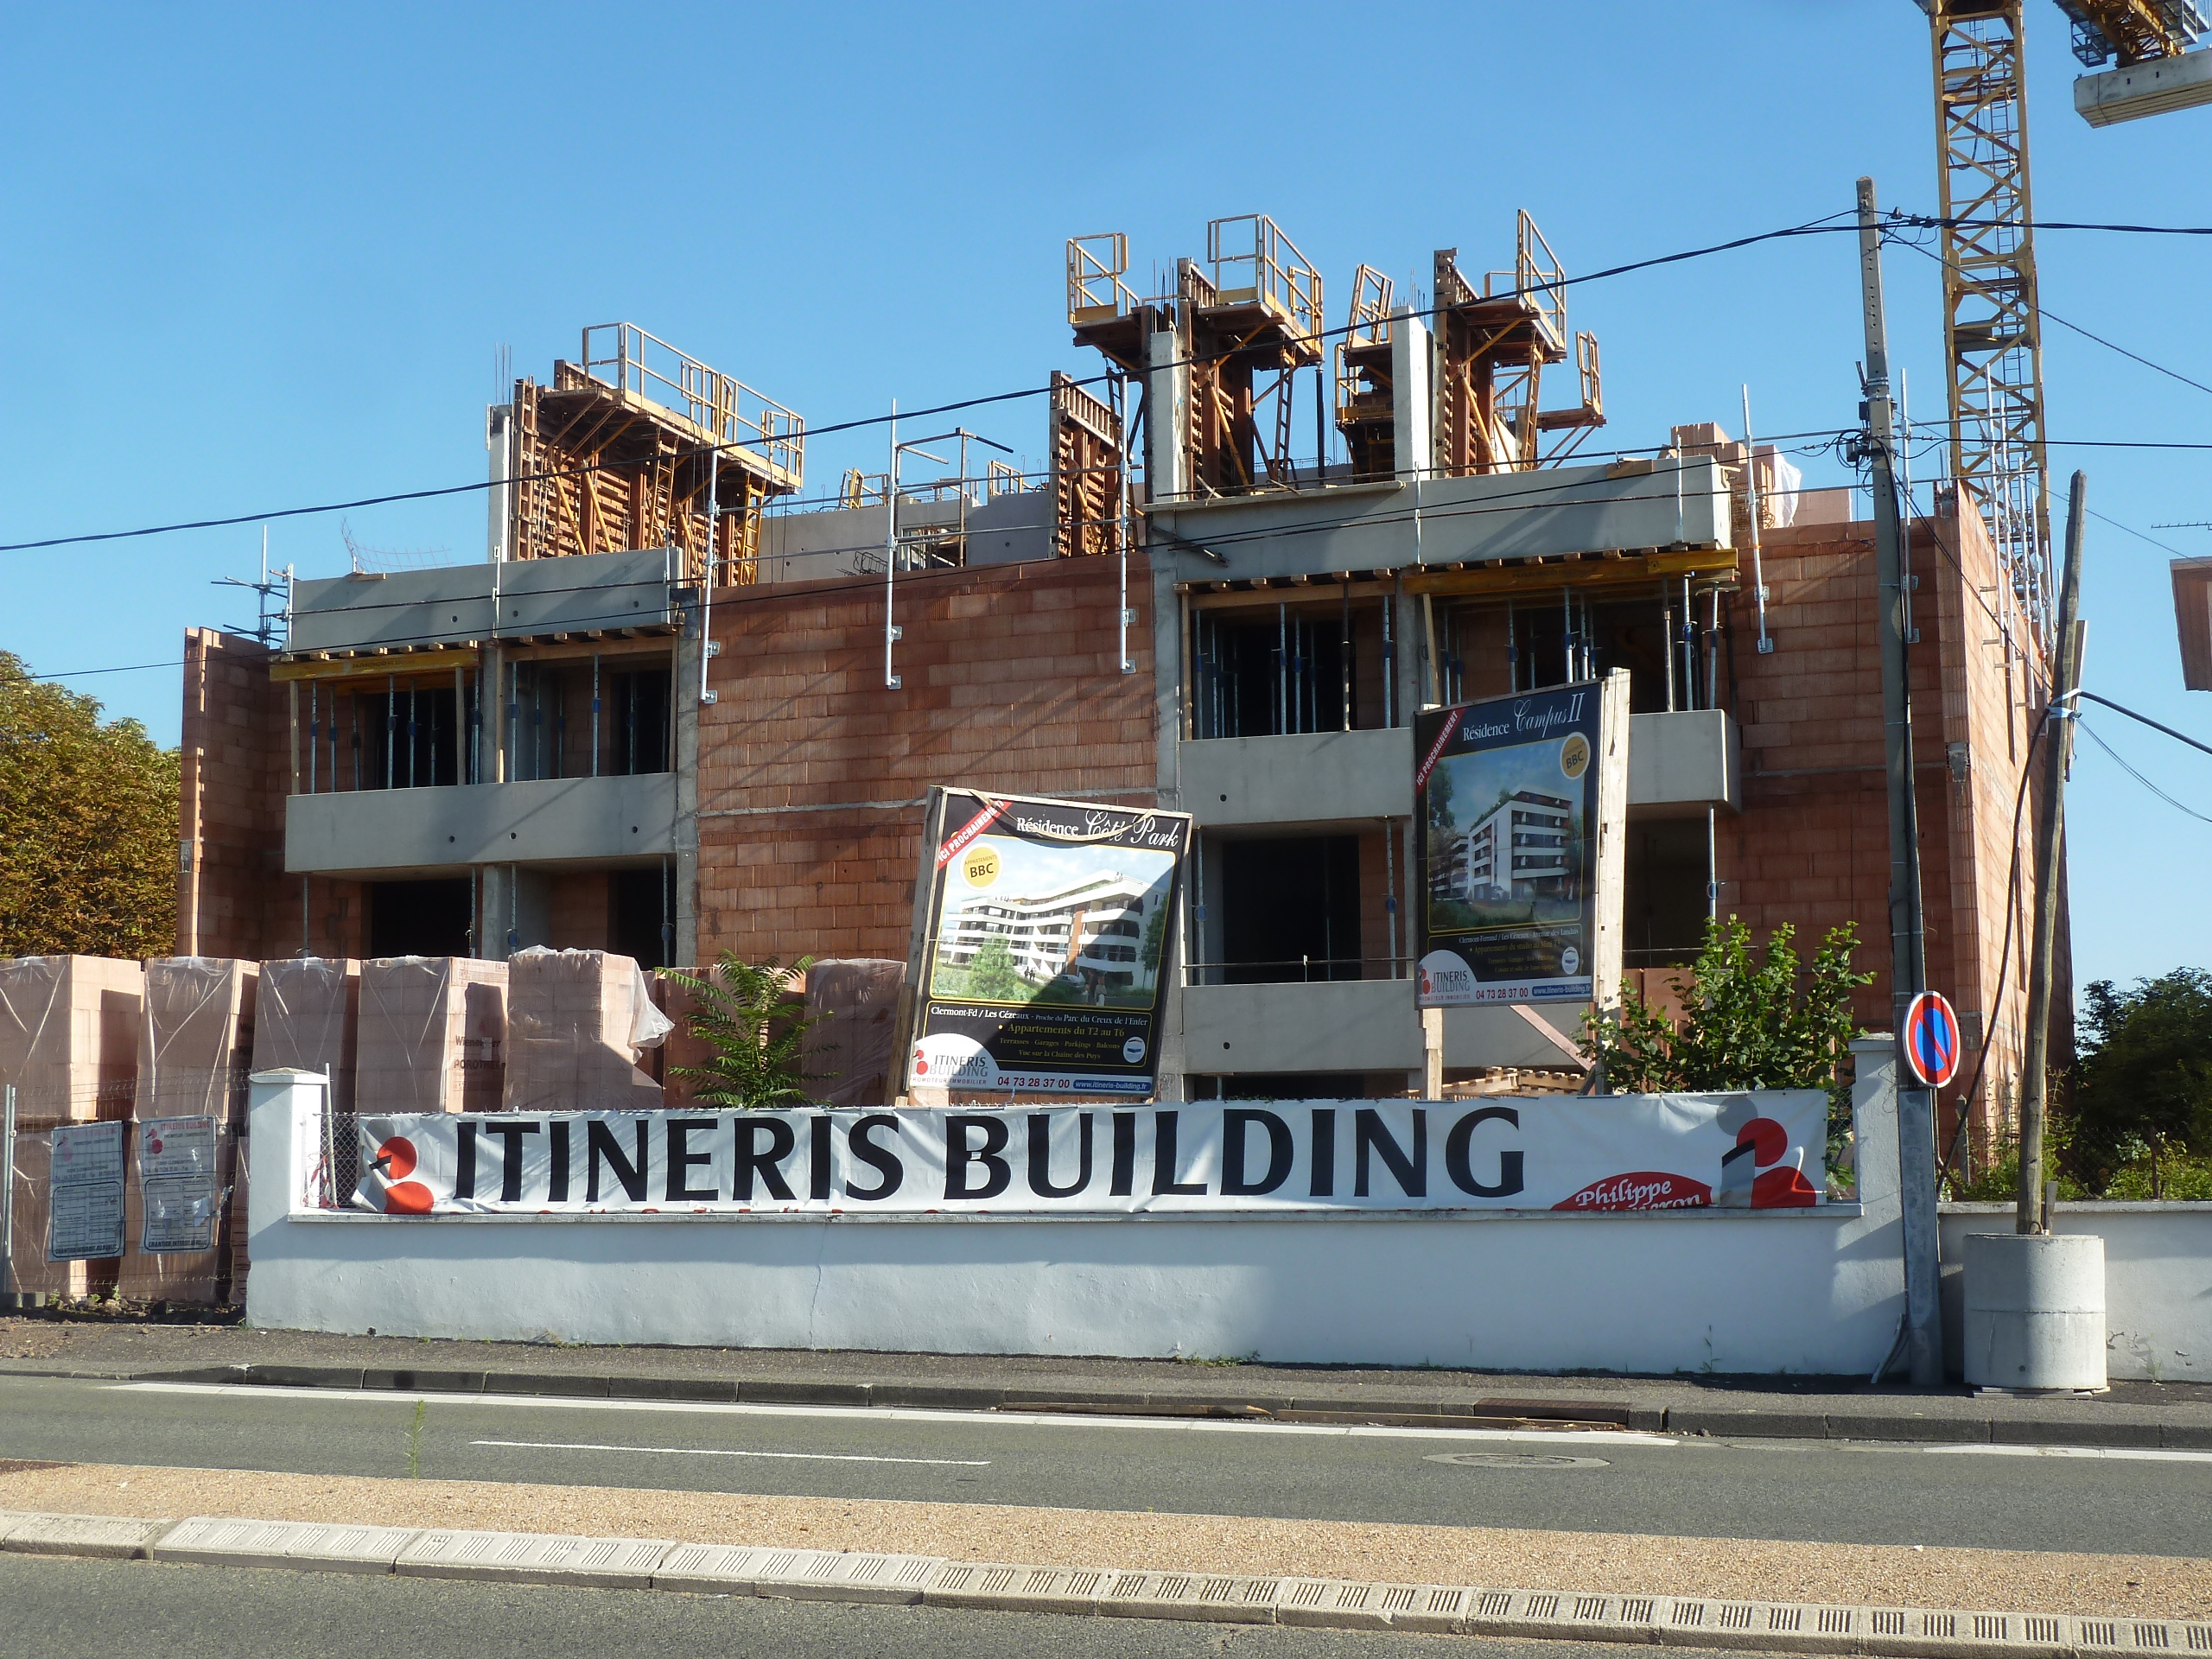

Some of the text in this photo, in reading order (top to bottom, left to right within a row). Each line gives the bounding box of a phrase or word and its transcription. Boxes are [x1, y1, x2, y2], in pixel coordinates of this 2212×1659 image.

[1464, 693, 1585, 741] Résidence Campus II
[1416, 710, 1458, 785] ICI PROCHAINEMENT
[1566, 751, 1585, 769] BBC
[1016, 817, 1079, 836] Résidence
[1131, 816, 1179, 847] Park
[938, 849, 950, 861] ICI
[965, 854, 997, 866] APPARTEMENTS
[970, 862, 994, 878] BBC
[1433, 970, 1467, 982] ITINERIS
[1431, 982, 1471, 994] BUILDING
[1476, 988, 1528, 1000] 04 73 28 37 00
[931, 1007, 978, 1018] Clermont-Fd
[985, 1009, 997, 1018] Les
[999, 1009, 1029, 1020] Cézeaux
[1063, 1014, 1078, 1022] Parc
[1080, 1014, 1090, 1023] du
[1091, 1015, 1113, 1024] Creux
[1115, 1016, 1123, 1025] de
[1007, 1023, 1125, 1037] Appartements du T2 au T6
[999, 1037, 1030, 1046] Terrasses
[1034, 1039, 1059, 1048] Garages
[1065, 1040, 1091, 1049] Parkings
[934, 1054, 987, 1068] ITINERIS
[1073, 1051, 1085, 1059] des
[930, 1065, 988, 1077] BUILDING
[997, 1077, 1070, 1088] 04 73 28 37 00
[1075, 1079, 1147, 1090] www.itineris-building.fr
[455, 1107, 1524, 1203] ITINERIS BUILDING
[1575, 1179, 1672, 1208] Philippe
